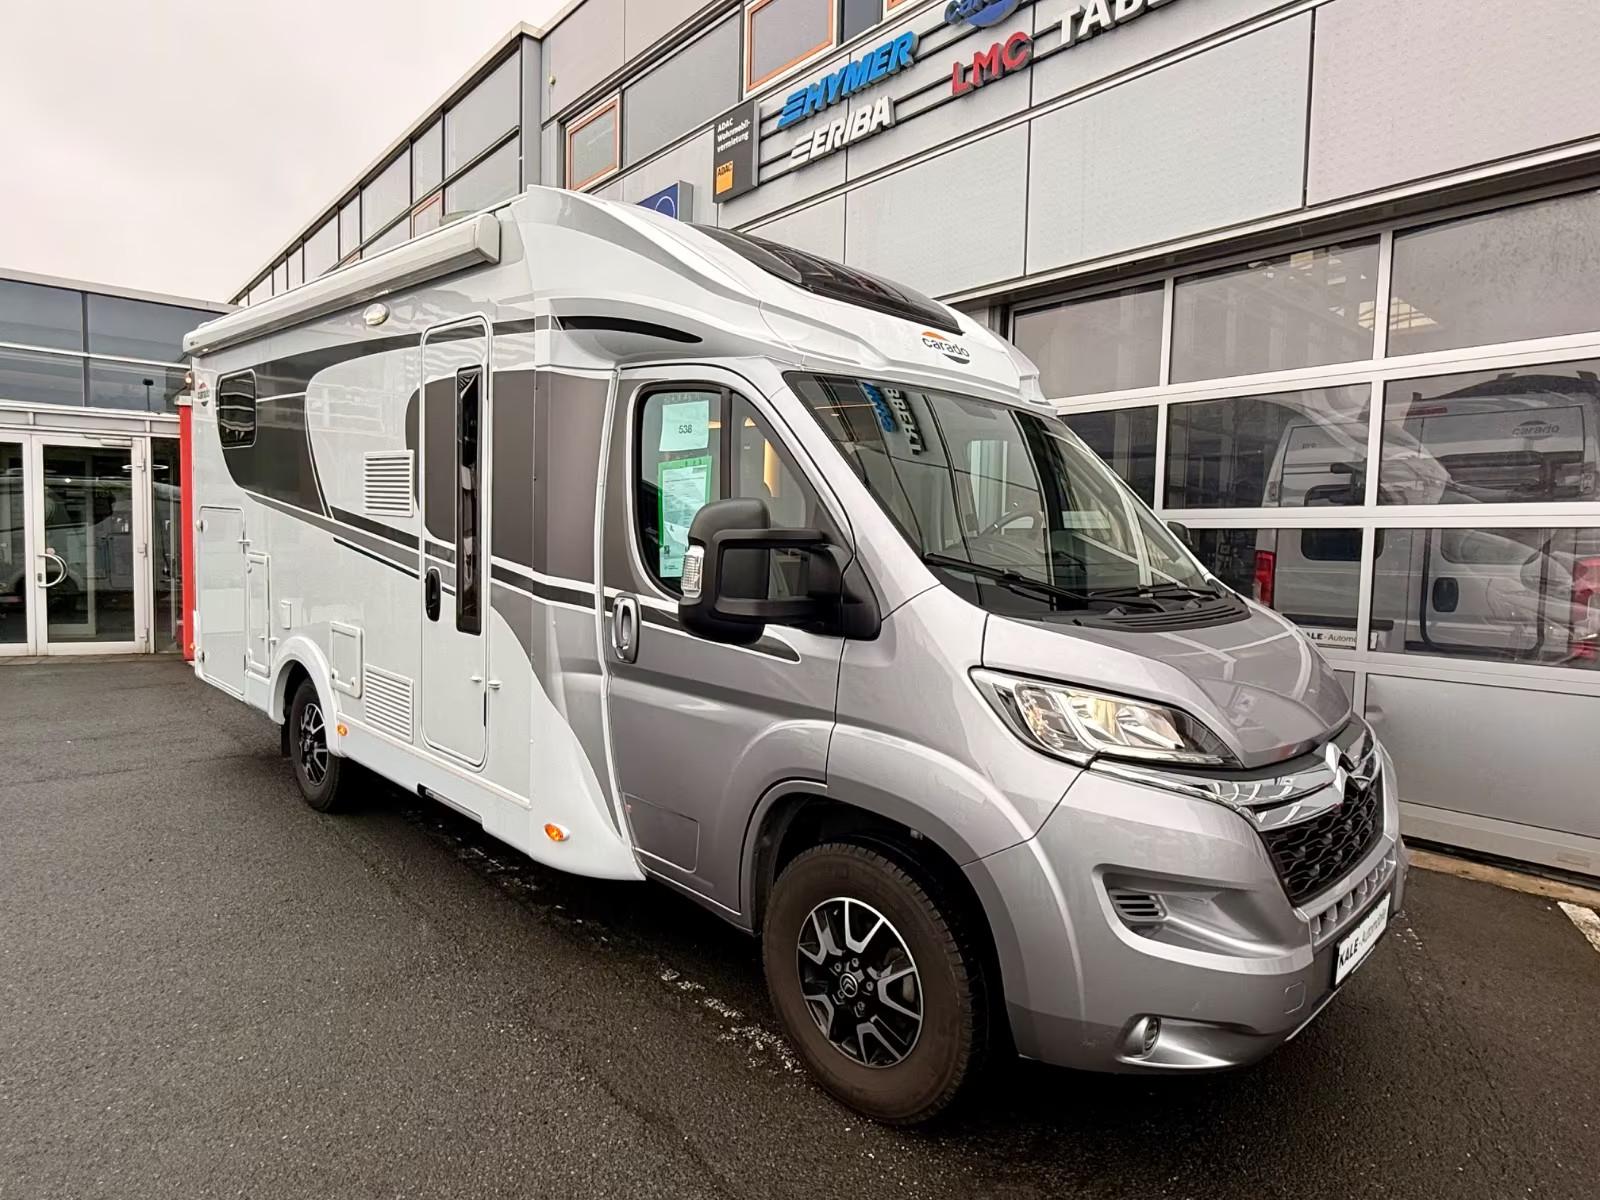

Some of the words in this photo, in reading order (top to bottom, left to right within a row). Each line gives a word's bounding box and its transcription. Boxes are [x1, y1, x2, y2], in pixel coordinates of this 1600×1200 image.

[1059, 0, 1158, 46] TAB
[798, 31, 918, 119] HYMER
[952, 31, 1031, 96] LMC
[717, 117, 734, 133] ADAC
[797, 96, 896, 164] ERIBA
[716, 131, 749, 153] vermietung
[717, 163, 733, 177] ADAC
[922, 337, 970, 358] carado
[1327, 633, 1358, 643] Automo
[1338, 937, 1359, 969] KALE
